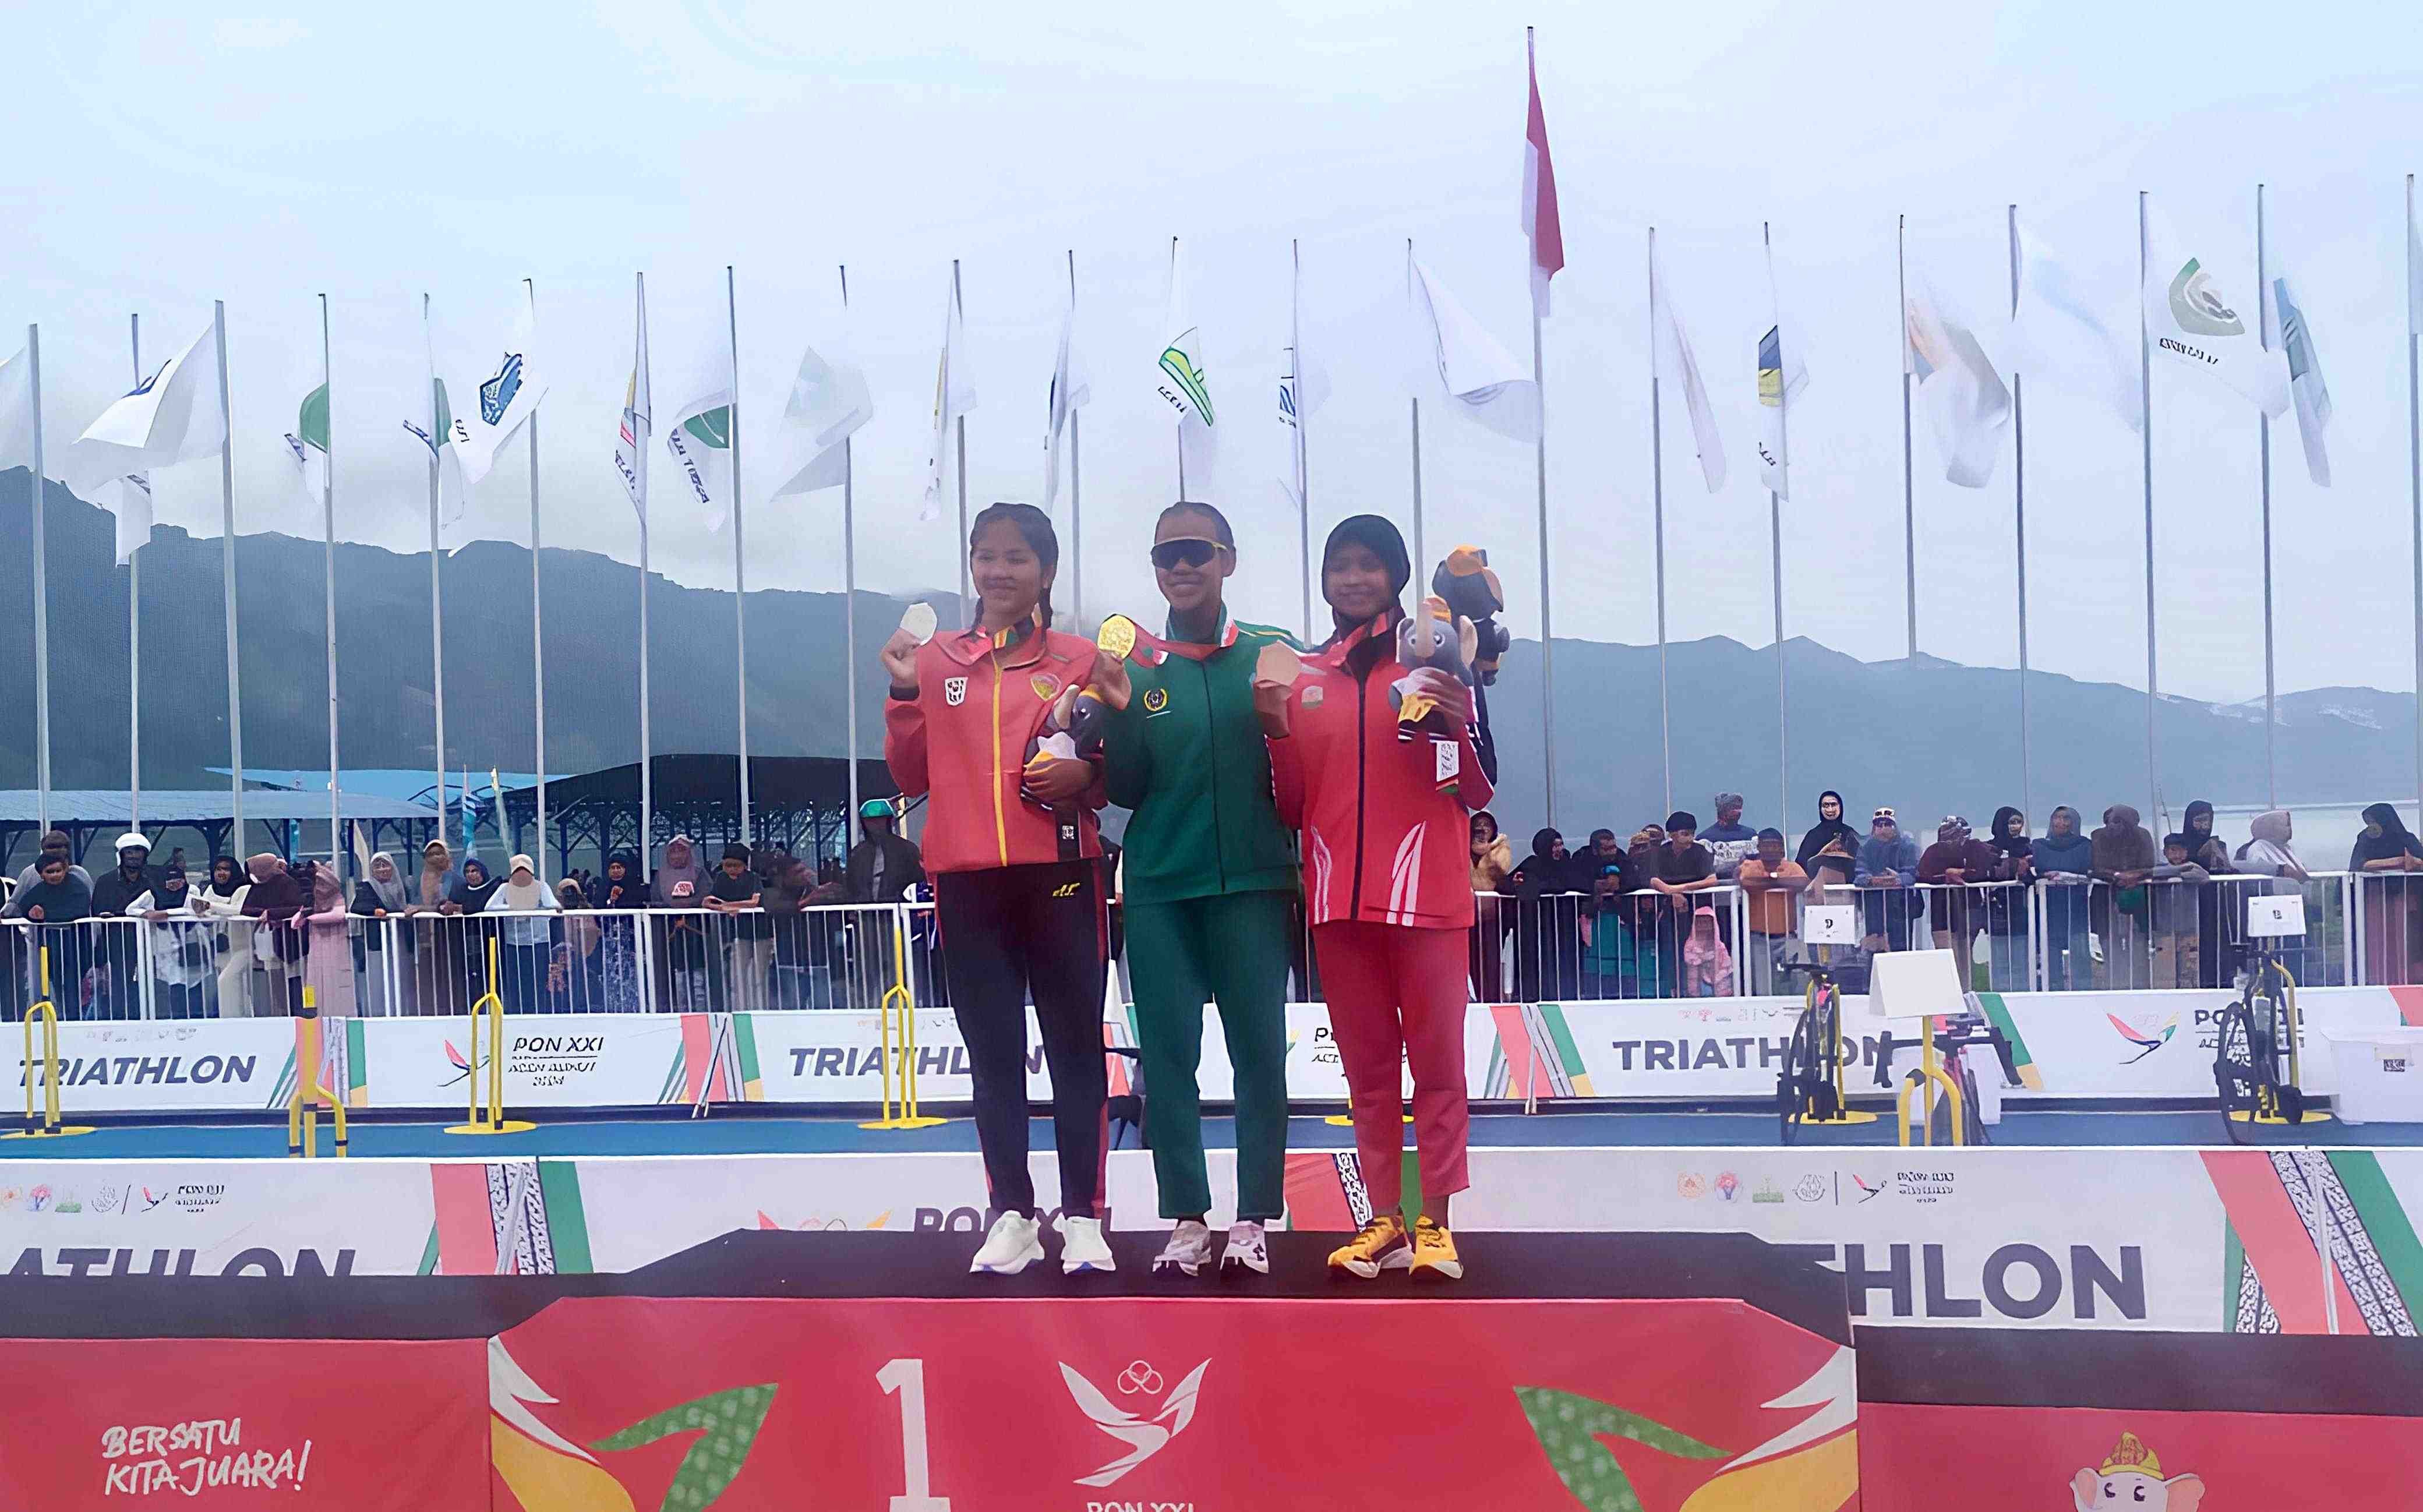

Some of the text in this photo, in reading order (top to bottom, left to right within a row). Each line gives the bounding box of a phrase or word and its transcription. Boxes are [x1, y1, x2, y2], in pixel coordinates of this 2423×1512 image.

[513, 1037, 604, 1052] PON XXI
[101, 1417, 241, 1458] BERSATU
[875, 1358, 952, 1512] 1
[104, 1439, 312, 1496] KITA JUARA!
